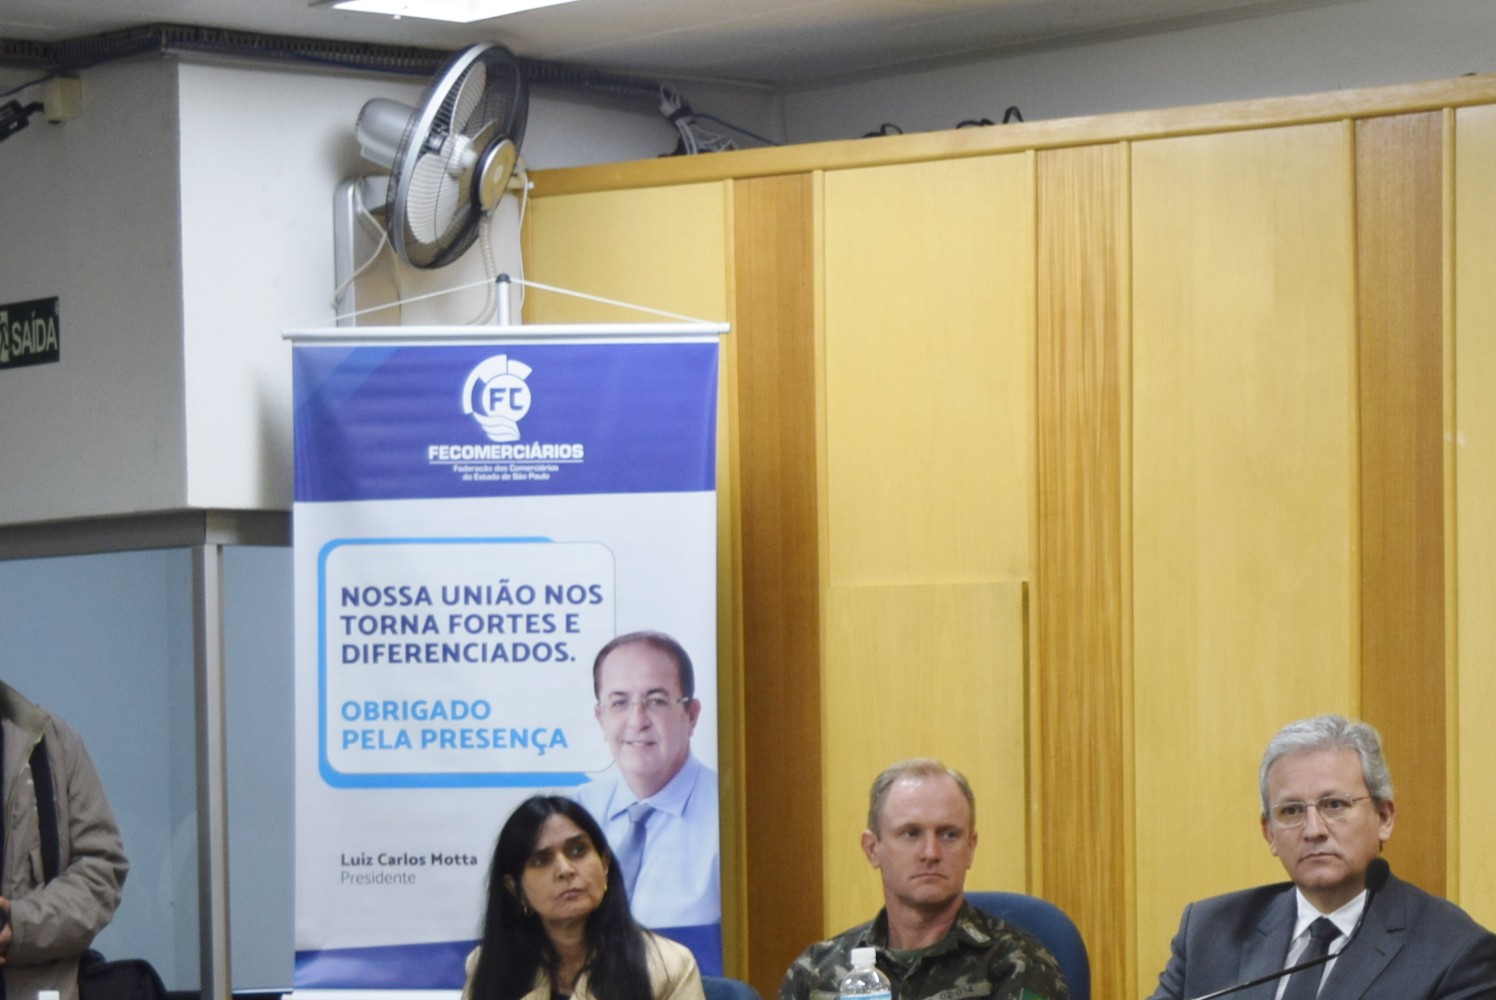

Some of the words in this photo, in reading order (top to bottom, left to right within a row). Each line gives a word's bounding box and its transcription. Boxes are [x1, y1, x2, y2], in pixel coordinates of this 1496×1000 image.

[12, 310, 58, 356] SAÍDA
[428, 441, 585, 460] FECOMERCIÁRIOS
[341, 585, 433, 607] NOSSA
[441, 578, 537, 606] UNIÃO
[544, 584, 604, 605] NOS
[340, 613, 440, 636] TORNA
[449, 612, 557, 635] FORTES
[565, 613, 581, 634] E
[341, 642, 577, 664] DIFERENCIADOS.
[341, 699, 492, 722] OBRIGADO
[342, 729, 413, 750] PELA
[421, 727, 569, 756] PRESENÇA
[341, 852, 374, 867] Luiz
[377, 852, 427, 867] Carlos
[431, 852, 478, 867] Motta
[341, 870, 417, 885] Presidente
